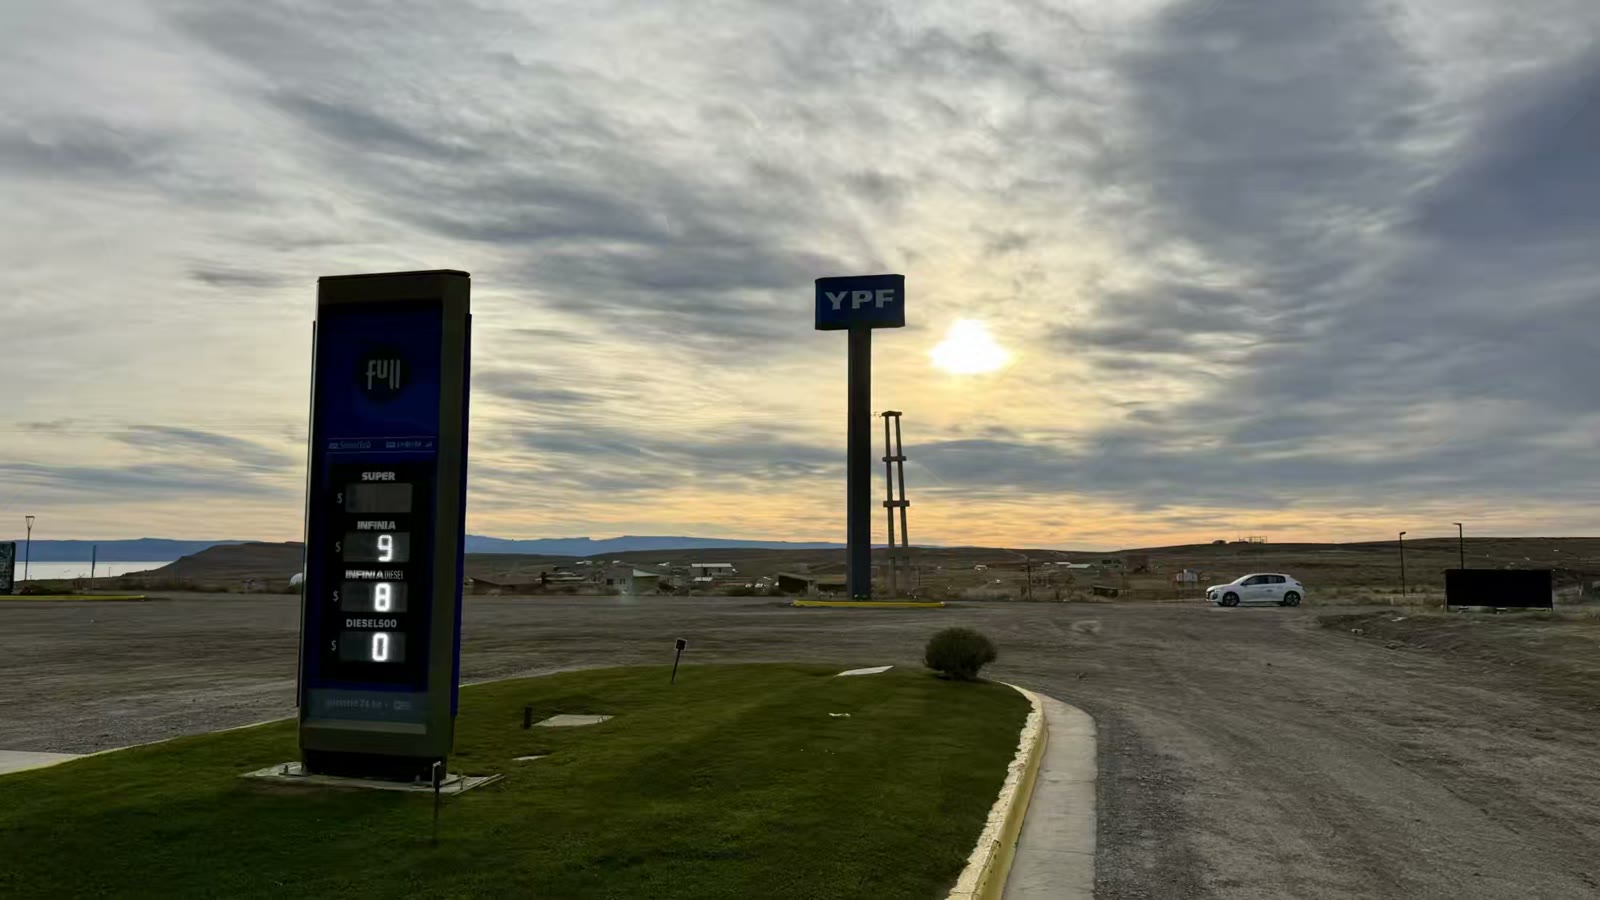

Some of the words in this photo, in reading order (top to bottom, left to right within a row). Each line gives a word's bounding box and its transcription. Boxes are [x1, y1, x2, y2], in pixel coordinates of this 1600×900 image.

[824, 289, 895, 310] YPF
[365, 358, 401, 390] full
[361, 471, 396, 481] SUPER
[357, 520, 396, 530] INFINIA
[377, 534, 393, 563] 9
[345, 569, 384, 580] INFINIA
[374, 582, 391, 613] 8
[372, 632, 389, 662] 0
